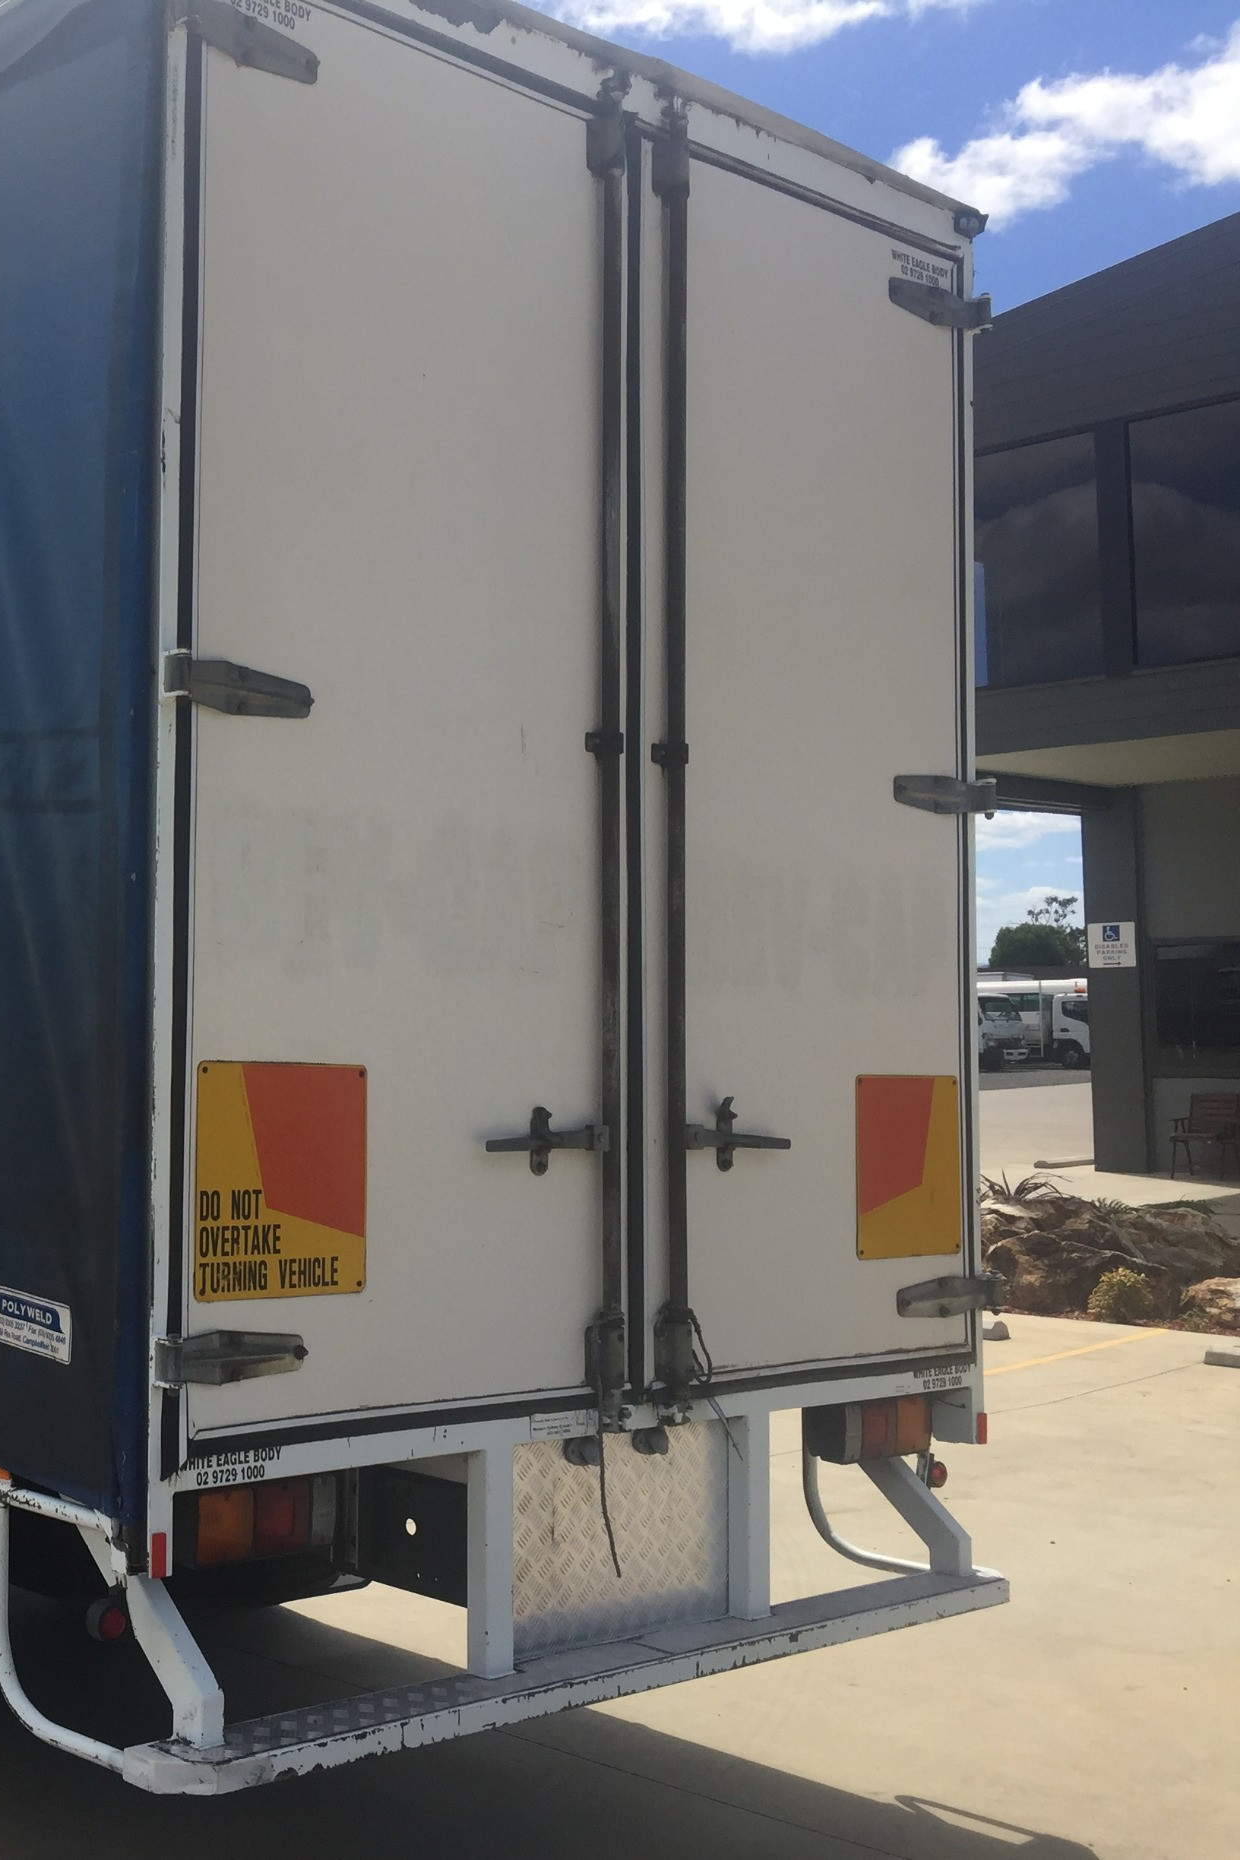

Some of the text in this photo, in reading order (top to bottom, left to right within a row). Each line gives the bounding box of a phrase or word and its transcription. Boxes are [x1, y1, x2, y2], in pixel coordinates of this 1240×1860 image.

[245, 0, 269, 18] 9729
[273, 10, 295, 30] 1000
[285, 0, 311, 21] BODY
[891, 249, 949, 279] WHITE EAGLE BODY
[901, 264, 909, 275] 02
[925, 273, 940, 286] 1000
[200, 1189, 262, 1221] DO NOT
[200, 1224, 281, 1258] OVERTAKE
[199, 1256, 339, 1295] TURNING VEHICLE
[1, 1298, 52, 1325] POLYWELD
[923, 1379, 931, 1390] 02
[932, 1377, 947, 1389] 9729
[948, 1375, 963, 1387] 1000
[934, 1365, 954, 1376] EAGLE
[216, 1451, 250, 1467] EAGLE
[254, 1447, 281, 1462] BODY
[196, 1464, 265, 1486] 02 9729 1000
